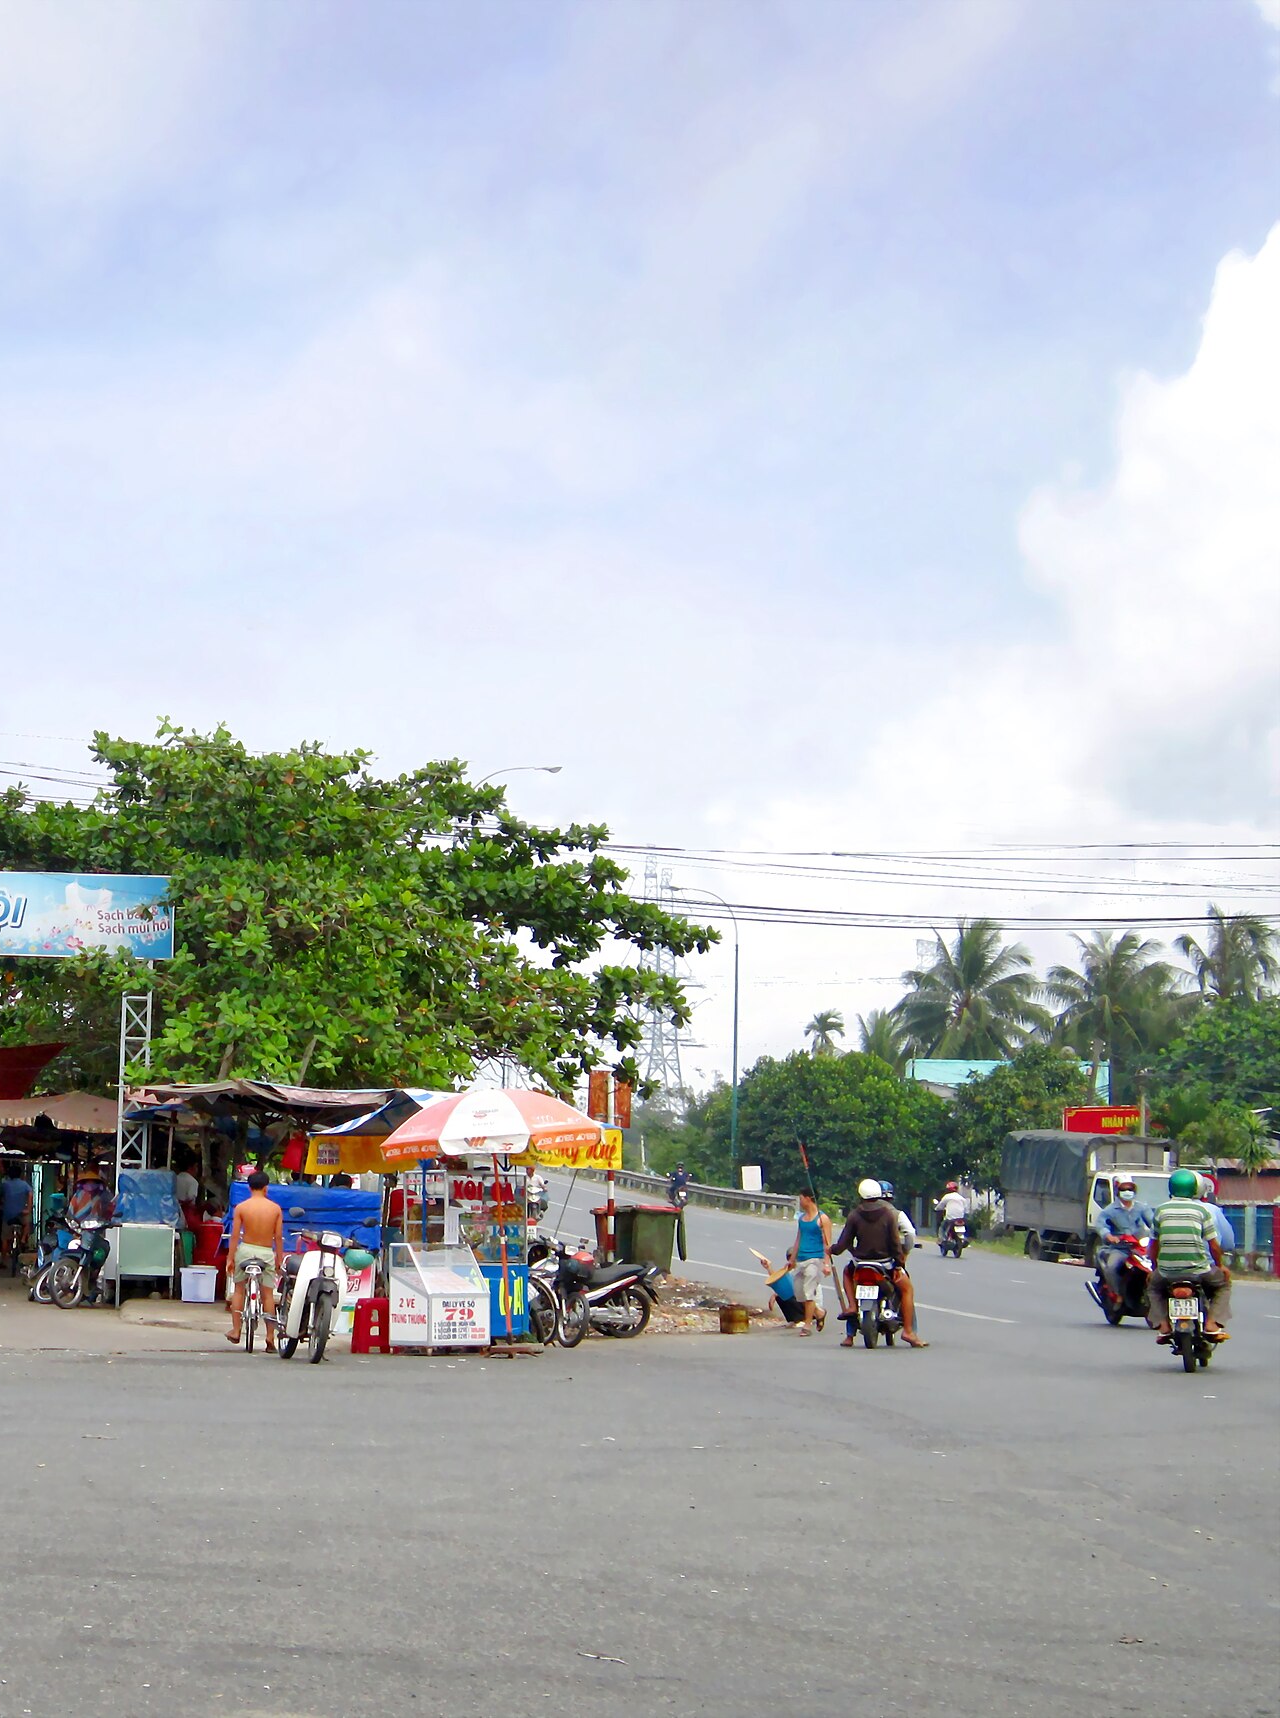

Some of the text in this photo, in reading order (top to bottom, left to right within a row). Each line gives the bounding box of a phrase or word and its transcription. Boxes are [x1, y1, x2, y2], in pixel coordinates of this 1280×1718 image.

[97, 908, 124, 922] Sạch
[98, 918, 170, 935] Sạch mùi hôi
[399, 1297, 404, 1308] 2
[444, 1308, 474, 1321] 79
